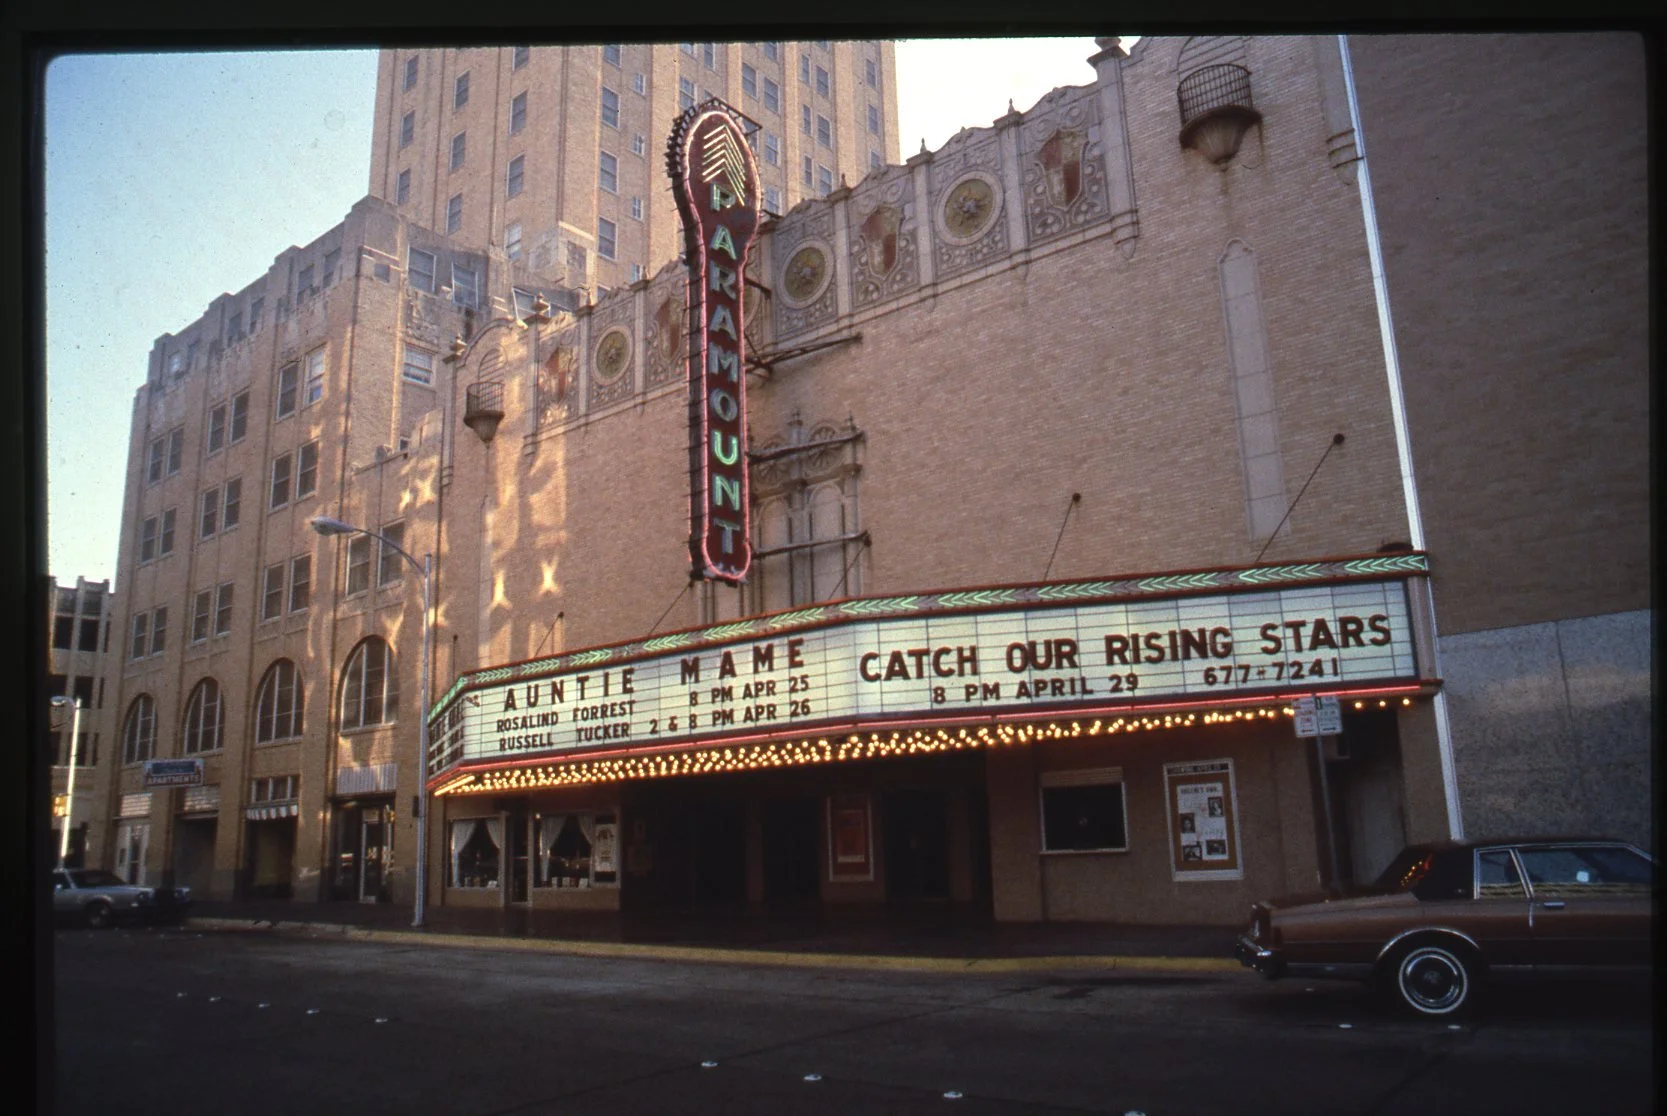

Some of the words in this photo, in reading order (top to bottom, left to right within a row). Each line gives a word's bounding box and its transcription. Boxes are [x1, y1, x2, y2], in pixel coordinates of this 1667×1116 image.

[709, 181, 740, 556] PARAMOUNT
[503, 668, 635, 712] AUNTIE
[680, 638, 805, 686] MAME
[859, 645, 978, 683] CATCH
[1006, 637, 1079, 674] OUR
[1105, 627, 1232, 666] RISING
[1260, 614, 1392, 655] STARS
[495, 710, 559, 733] ROSALIND
[572, 699, 636, 723] FORREST
[688, 690, 699, 707] 8
[711, 686, 734, 705] PM
[742, 680, 777, 700] APR
[789, 675, 810, 694] 25
[932, 685, 947, 705] 8
[964, 681, 1001, 702] PM
[1016, 674, 1095, 699] APRIL
[1109, 673, 1139, 693] 29
[1203, 658, 1340, 687] 677-7241
[498, 732, 554, 752] RUSSELL
[575, 723, 630, 743] TUCKER
[648, 718, 659, 735] 2
[667, 715, 679, 732] &
[688, 714, 698, 731] 8
[711, 709, 735, 728] PM
[743, 704, 777, 724] APR
[789, 698, 812, 718] 26
[147, 774, 200, 784] APARTMENTS
